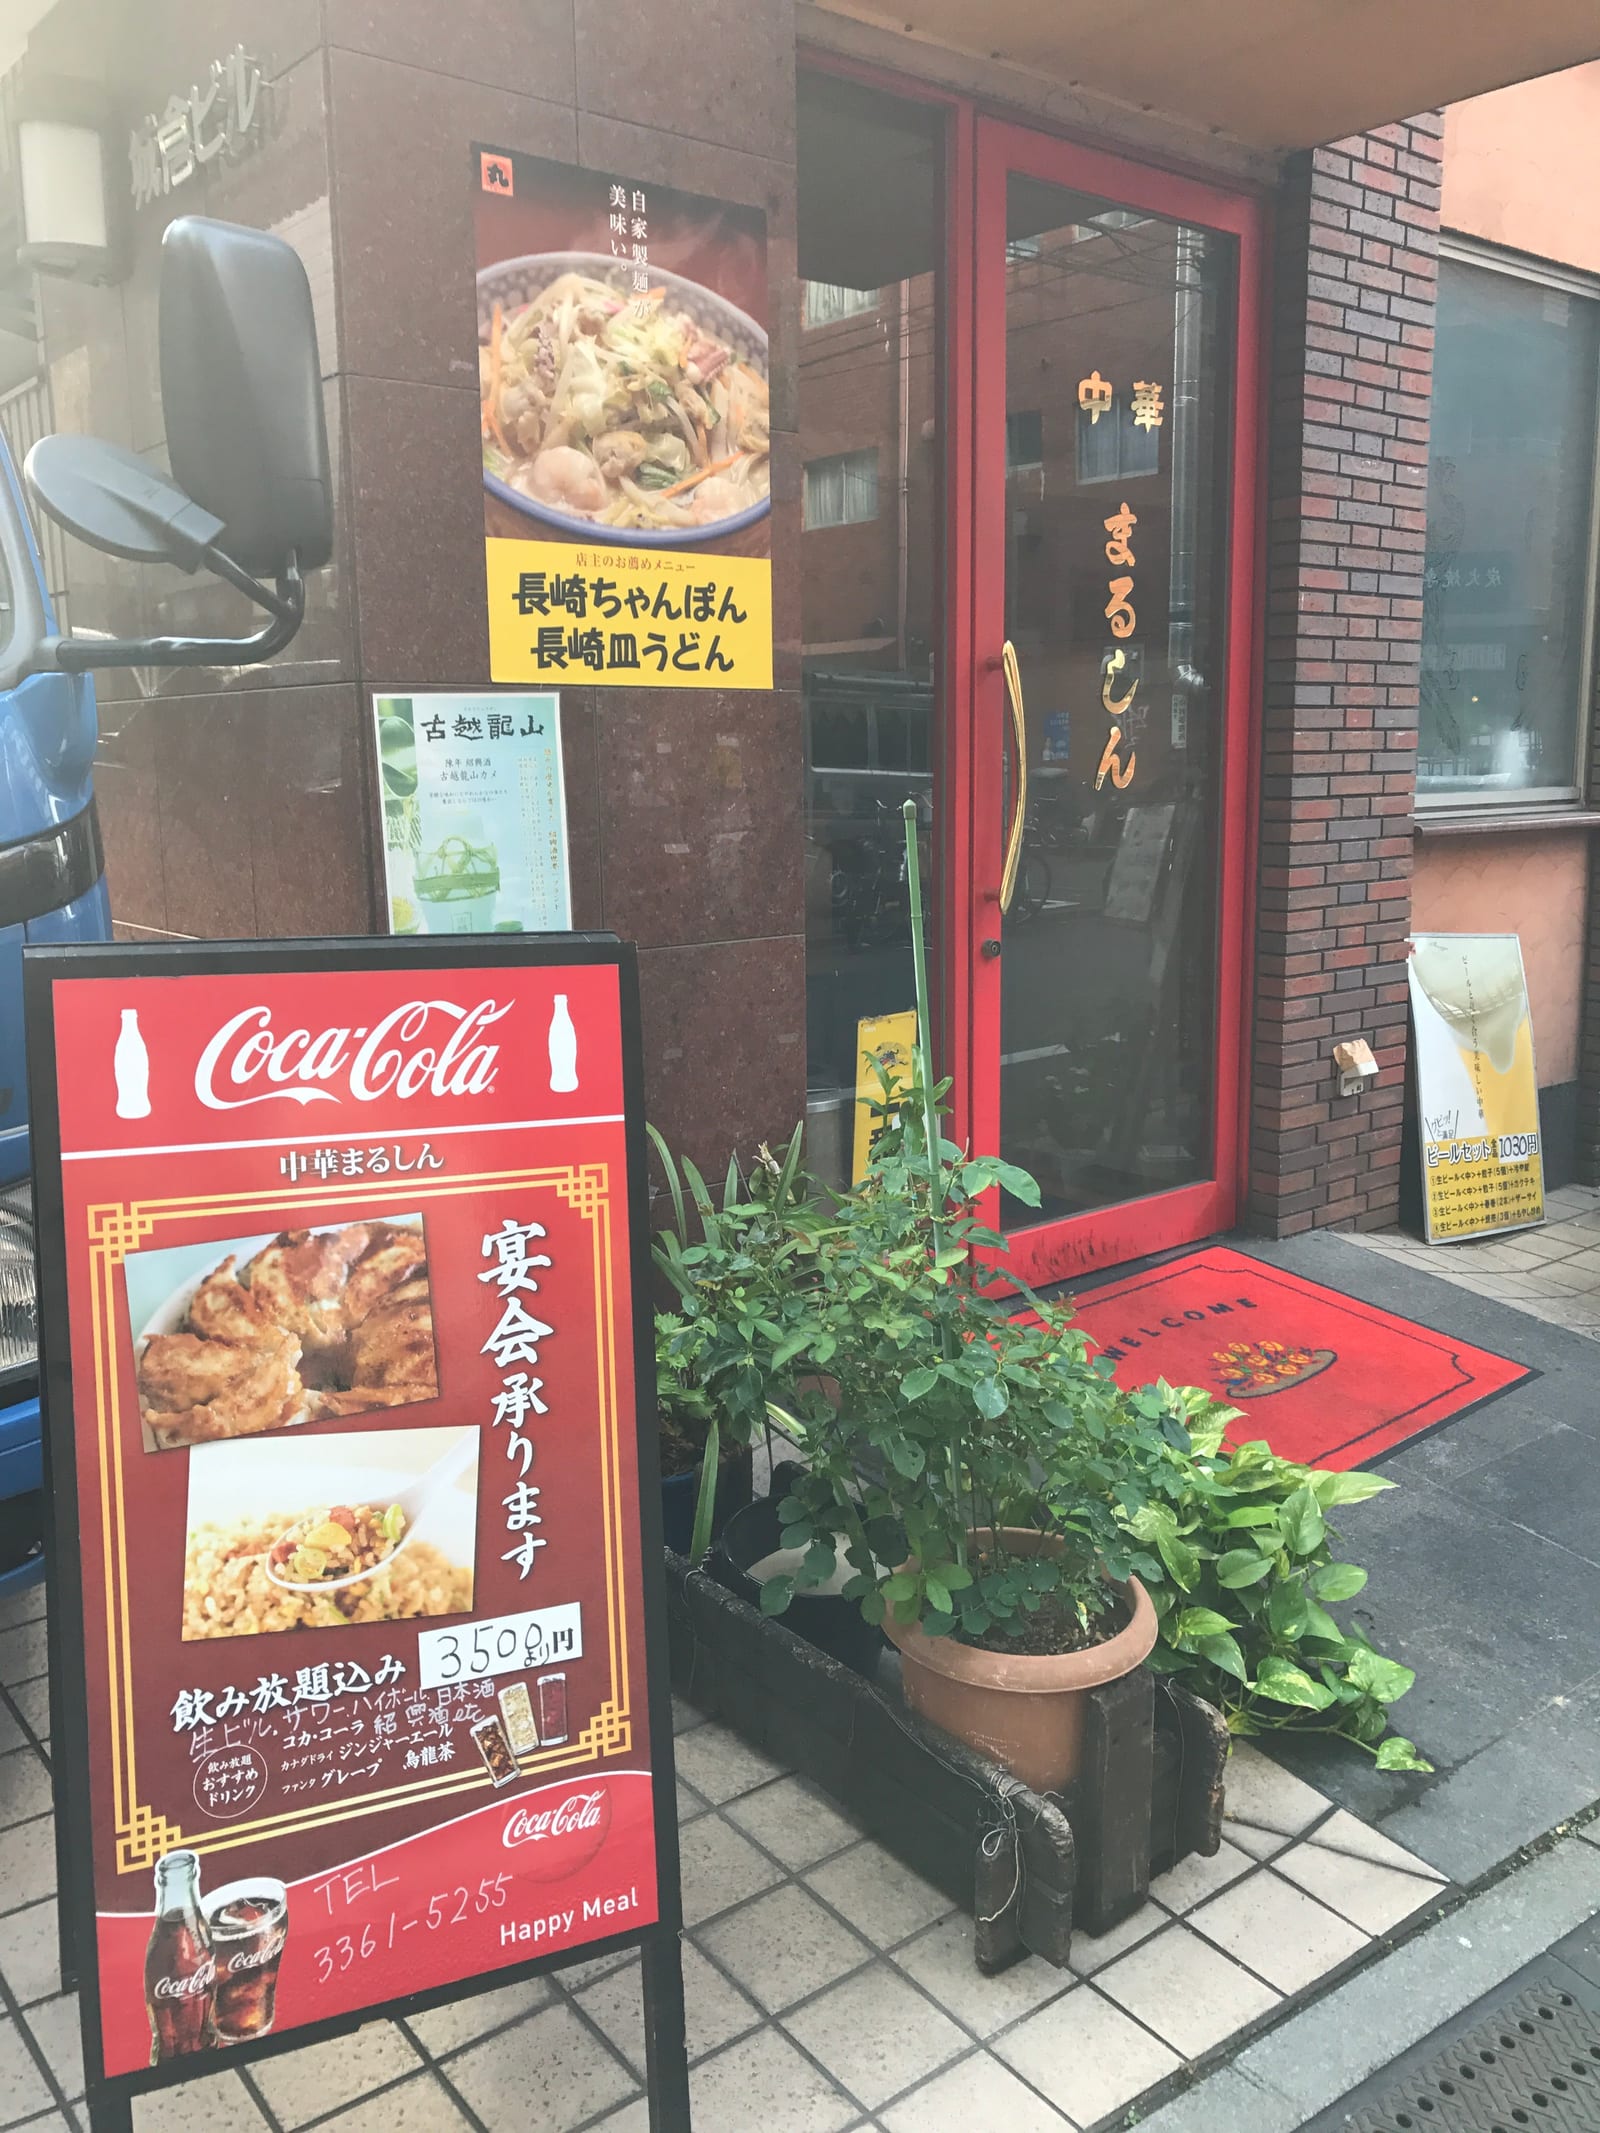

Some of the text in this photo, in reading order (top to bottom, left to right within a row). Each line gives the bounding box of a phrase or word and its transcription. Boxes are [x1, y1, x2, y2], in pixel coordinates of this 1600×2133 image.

[609, 184, 628, 272] 美味い。
[631, 190, 651, 318] 自家製麺が
[1078, 371, 1163, 432] 中華
[575, 552, 696, 572] 店主のお薦めメニュー
[512, 572, 747, 623] 長崎ちゃんぽん
[530, 626, 734, 672] 長崎皿うどん
[1094, 502, 1138, 791] まるしん
[420, 713, 544, 742] 古越龍山
[195, 998, 515, 1111] Coca-Cola
[279, 1142, 444, 1183] 中華まるしん
[1426, 1139, 1491, 1167] ビールセット
[1498, 1133, 1539, 1159] 1030円
[1101, 1297, 1258, 1361] WELCOME
[477, 1219, 555, 1581] 宴会承ります
[170, 1653, 406, 1733] 飲み放題込み
[438, 1678, 495, 1706] 日本酒
[281, 1724, 453, 1772] カナダドライ ジンジャーエール
[283, 1719, 364, 1749] コカ・コーラ
[203, 1767, 259, 1792] おすすめ
[208, 1754, 252, 1775] 飲み放題
[282, 1758, 383, 1795] ファンタ グレープ
[209, 1785, 256, 1807] ドリンク
[502, 1789, 606, 1848] Coca-Cola
[314, 1864, 399, 1915] TEL
[314, 1872, 513, 1983] 3361-5255
[500, 1886, 638, 1946] Happy Meal
